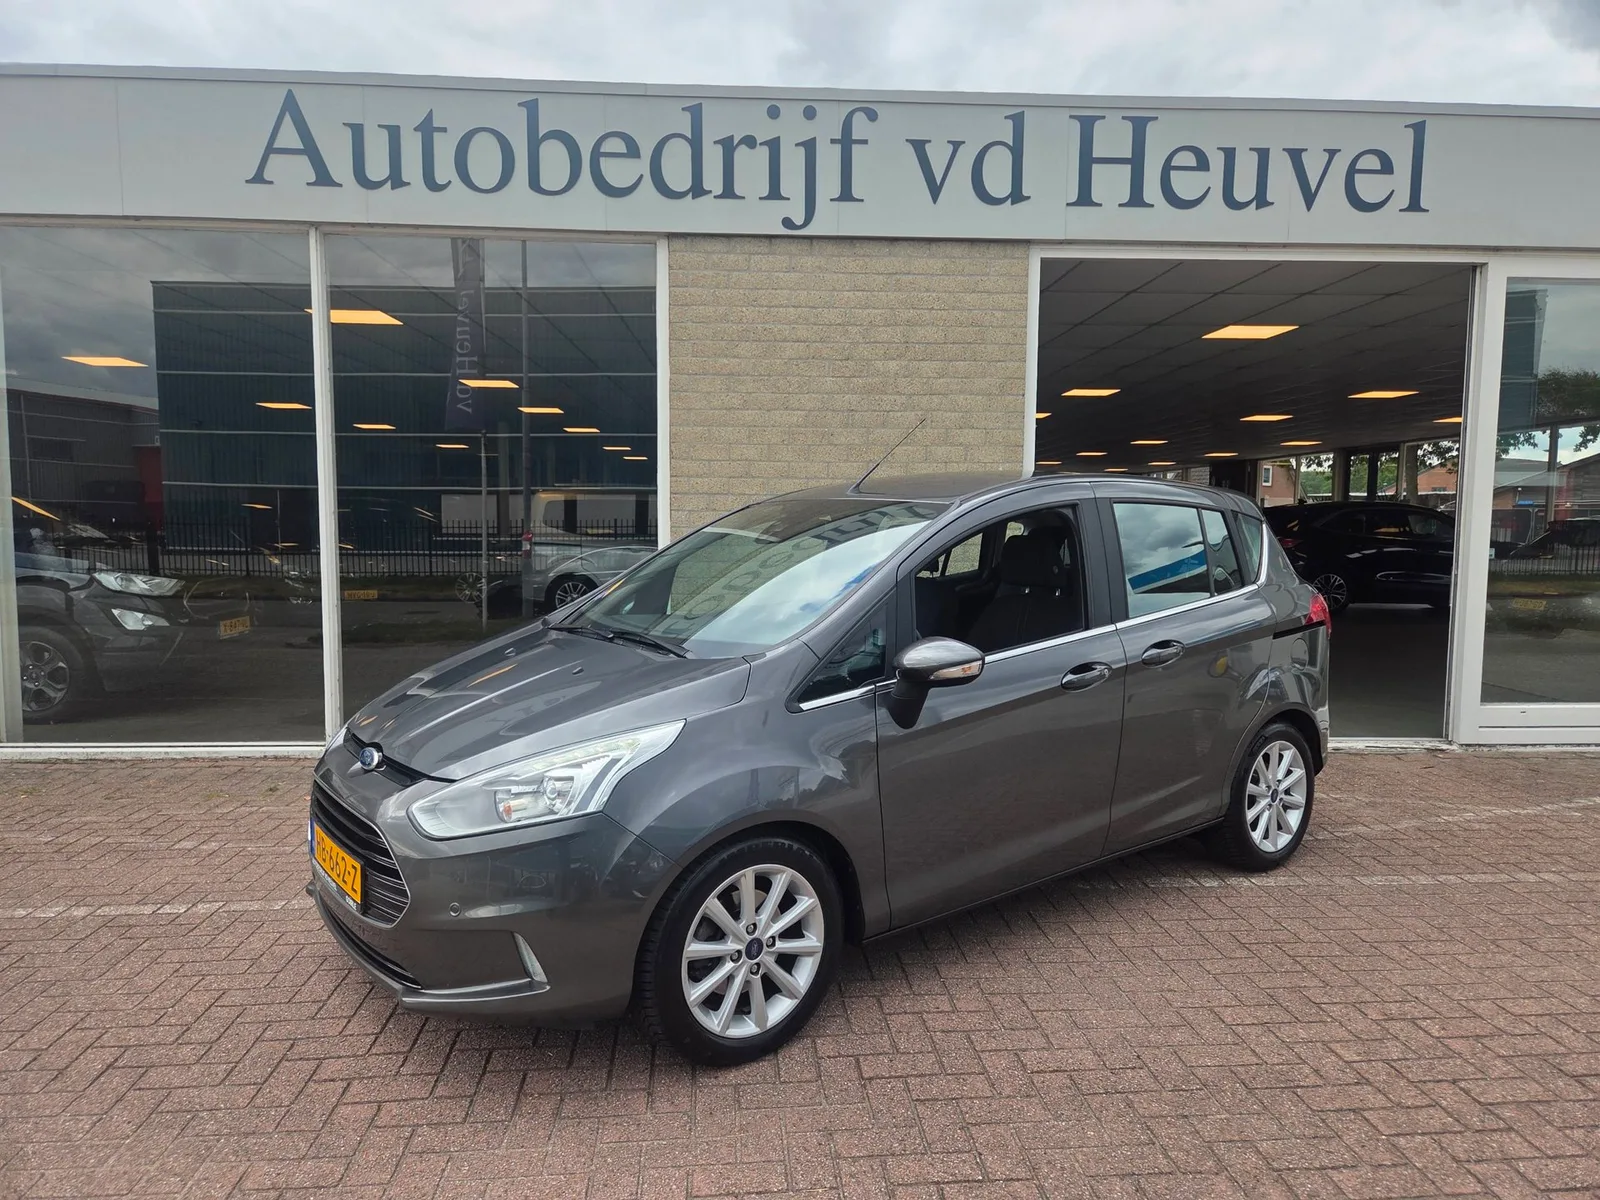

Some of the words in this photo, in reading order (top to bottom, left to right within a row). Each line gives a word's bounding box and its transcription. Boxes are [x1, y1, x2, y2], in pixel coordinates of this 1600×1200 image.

[244, 88, 879, 231] Autobedrijf
[905, 110, 1031, 206] vd
[1066, 113, 1430, 213] Heuvel
[316, 832, 358, 895] HB-662-Z
